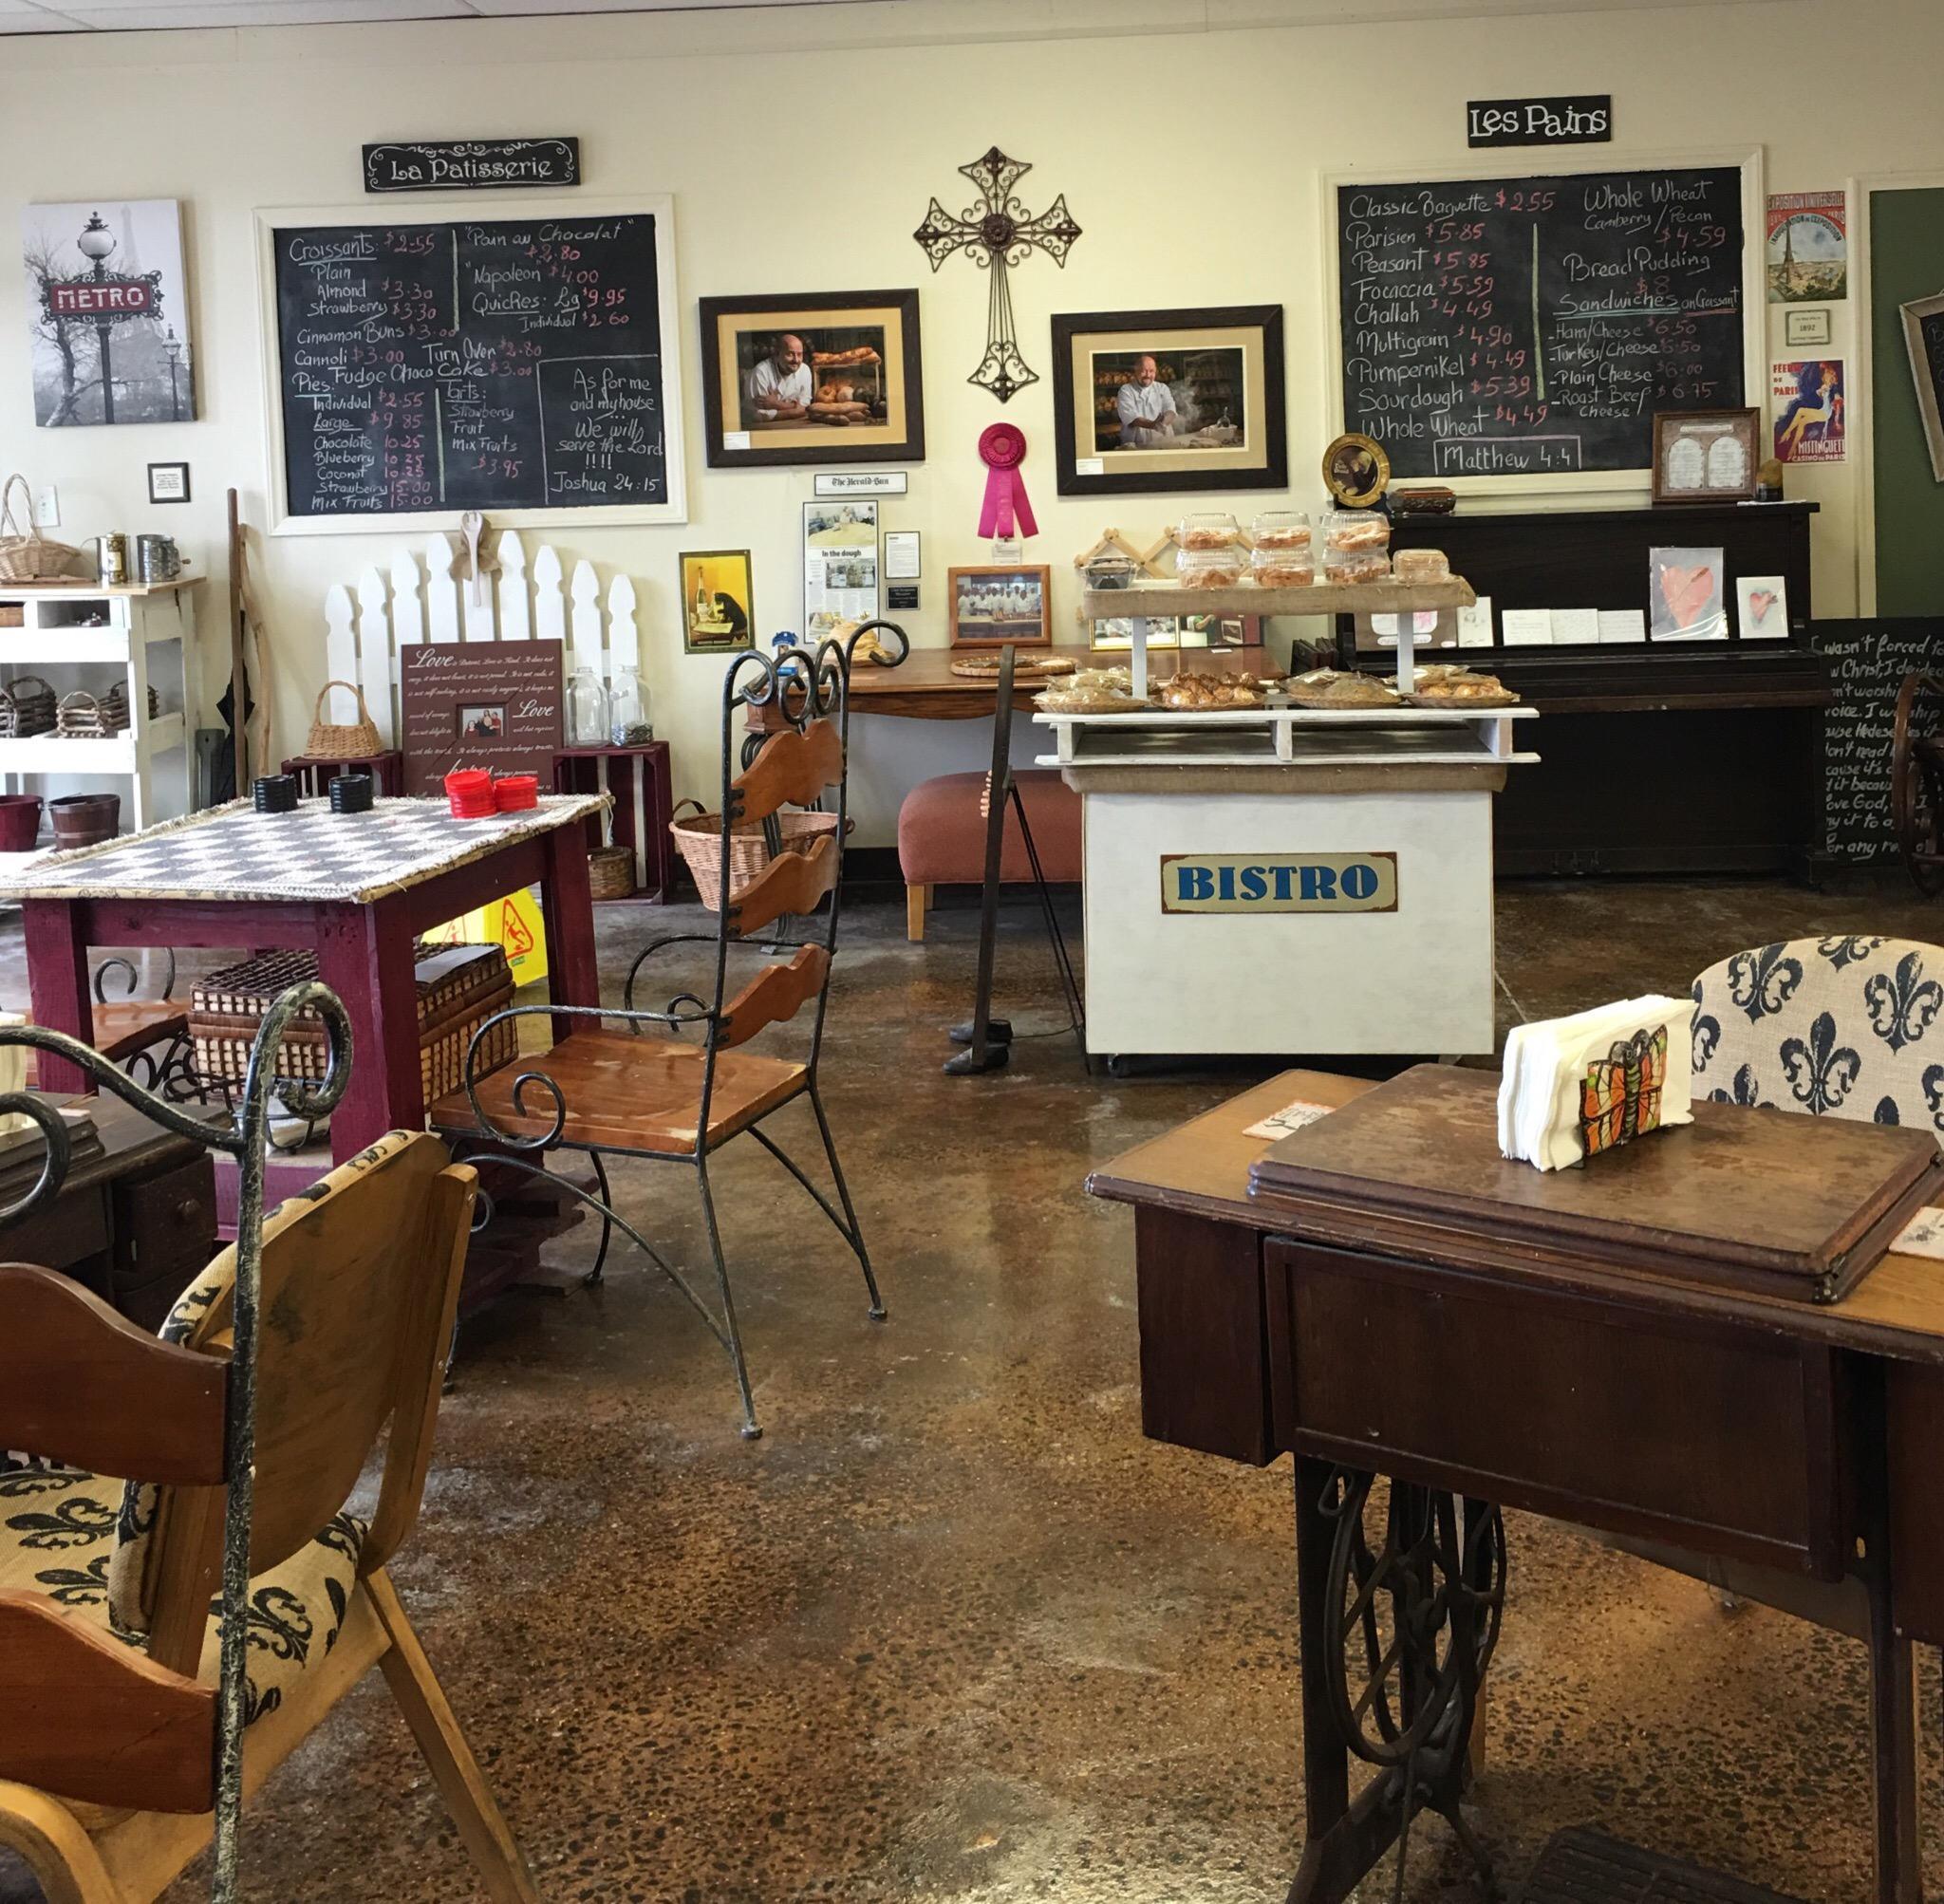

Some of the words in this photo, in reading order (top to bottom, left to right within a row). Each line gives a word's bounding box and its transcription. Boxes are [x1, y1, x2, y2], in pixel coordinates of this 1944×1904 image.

[1470, 109, 1519, 137] Les
[1524, 105, 1606, 137] Pains
[391, 160, 422, 180] La
[429, 158, 553, 182] Patisserie
[1349, 195, 1418, 218] Classic
[1418, 191, 1492, 222] Baguette
[1584, 181, 1643, 213] Whole
[1651, 179, 1713, 204] Wheat
[1346, 221, 1416, 250] Parisien
[310, 264, 351, 280] Plain
[1352, 247, 1430, 274] Peasant
[1563, 248, 1632, 282] Bread
[1634, 247, 1710, 275] Pudding
[58, 287, 143, 309] METRO
[318, 279, 366, 301] Almond
[1350, 277, 1436, 301] Focaccia
[1555, 289, 1679, 314] Sandwiches
[308, 301, 387, 327] Strawberry
[518, 313, 576, 332] Individual
[1355, 301, 1420, 326] Challah
[297, 329, 362, 345] Cinnamon
[364, 321, 404, 343] Buns
[1356, 328, 1449, 358] Multigrain
[294, 347, 347, 365] Cannoli
[422, 343, 460, 364] Turn
[463, 337, 495, 360] Over
[327, 366, 386, 388] Fudge
[391, 364, 433, 383] Choco
[438, 361, 489, 377] Cake
[1347, 354, 1465, 387] Pumpernikel
[1598, 362, 1654, 383] Cheese
[573, 367, 596, 400] As
[601, 367, 626, 402] for
[630, 378, 652, 390] me
[313, 391, 371, 411] Individual
[570, 393, 593, 411] and
[594, 399, 617, 420] my
[619, 392, 655, 410] house
[1358, 382, 1463, 416] Sourdough
[1362, 414, 1424, 441] Whole
[1430, 405, 1490, 438] Wheat
[1580, 405, 1631, 418] Cheese
[313, 412, 354, 435] Large
[450, 420, 485, 434] Fruit
[575, 417, 604, 438] We
[610, 418, 638, 439] will
[314, 434, 373, 450] Chocolate
[478, 435, 517, 452] Fruits
[555, 439, 595, 452] serve
[600, 437, 625, 454] the
[628, 427, 664, 456] Lord
[313, 451, 375, 467] Blueberry
[1444, 444, 1530, 470] Matthew
[317, 465, 367, 479] Coconut
[551, 471, 607, 493] Joshua
[613, 473, 660, 492] 24:15
[315, 481, 388, 495] Strawberry
[343, 494, 383, 510] Fruits
[841, 550, 861, 558] dough
[408, 648, 455, 668] Love
[1824, 635, 1875, 655] wasn't
[1876, 633, 1931, 661] forced
[513, 700, 554, 718] Love
[1856, 741, 1890, 758] read
[1850, 775, 1893, 792] becaus
[1863, 813, 1879, 829] to
[1177, 864, 1378, 900] BISTRO
